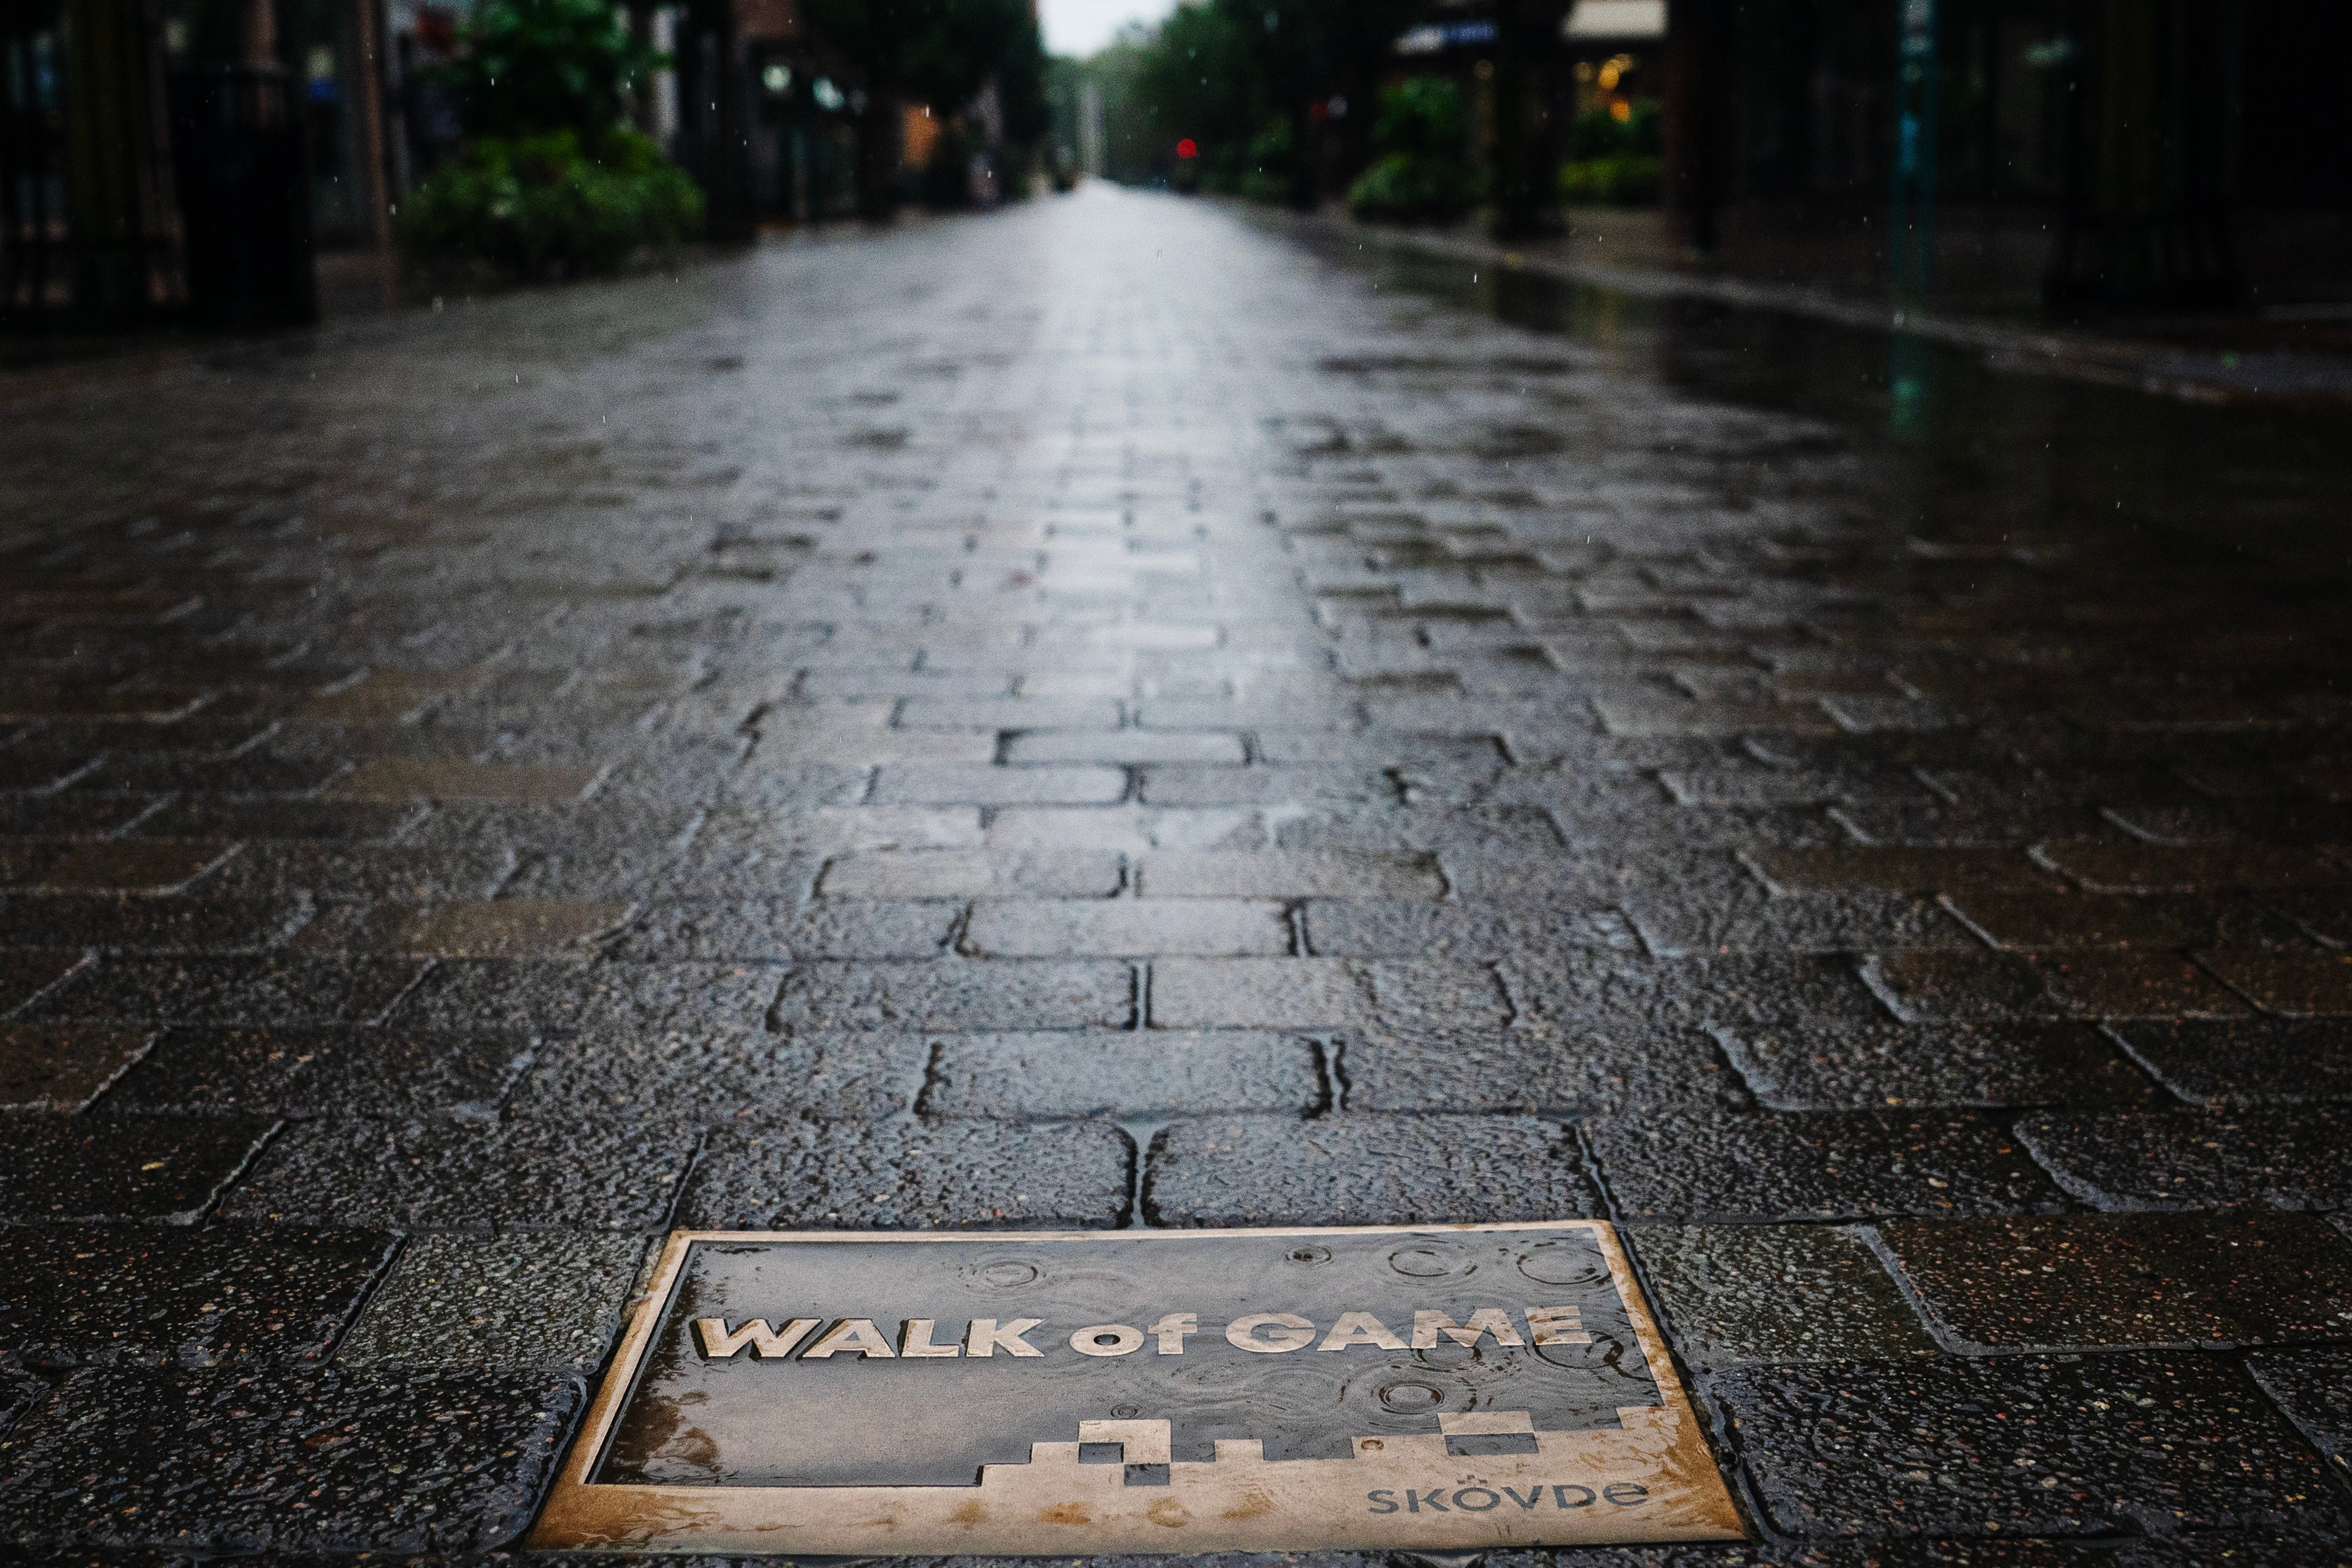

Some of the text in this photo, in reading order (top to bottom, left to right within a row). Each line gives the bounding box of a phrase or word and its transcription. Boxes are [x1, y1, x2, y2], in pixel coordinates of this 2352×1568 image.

[695, 1305, 1592, 1358] WALK of GAME
